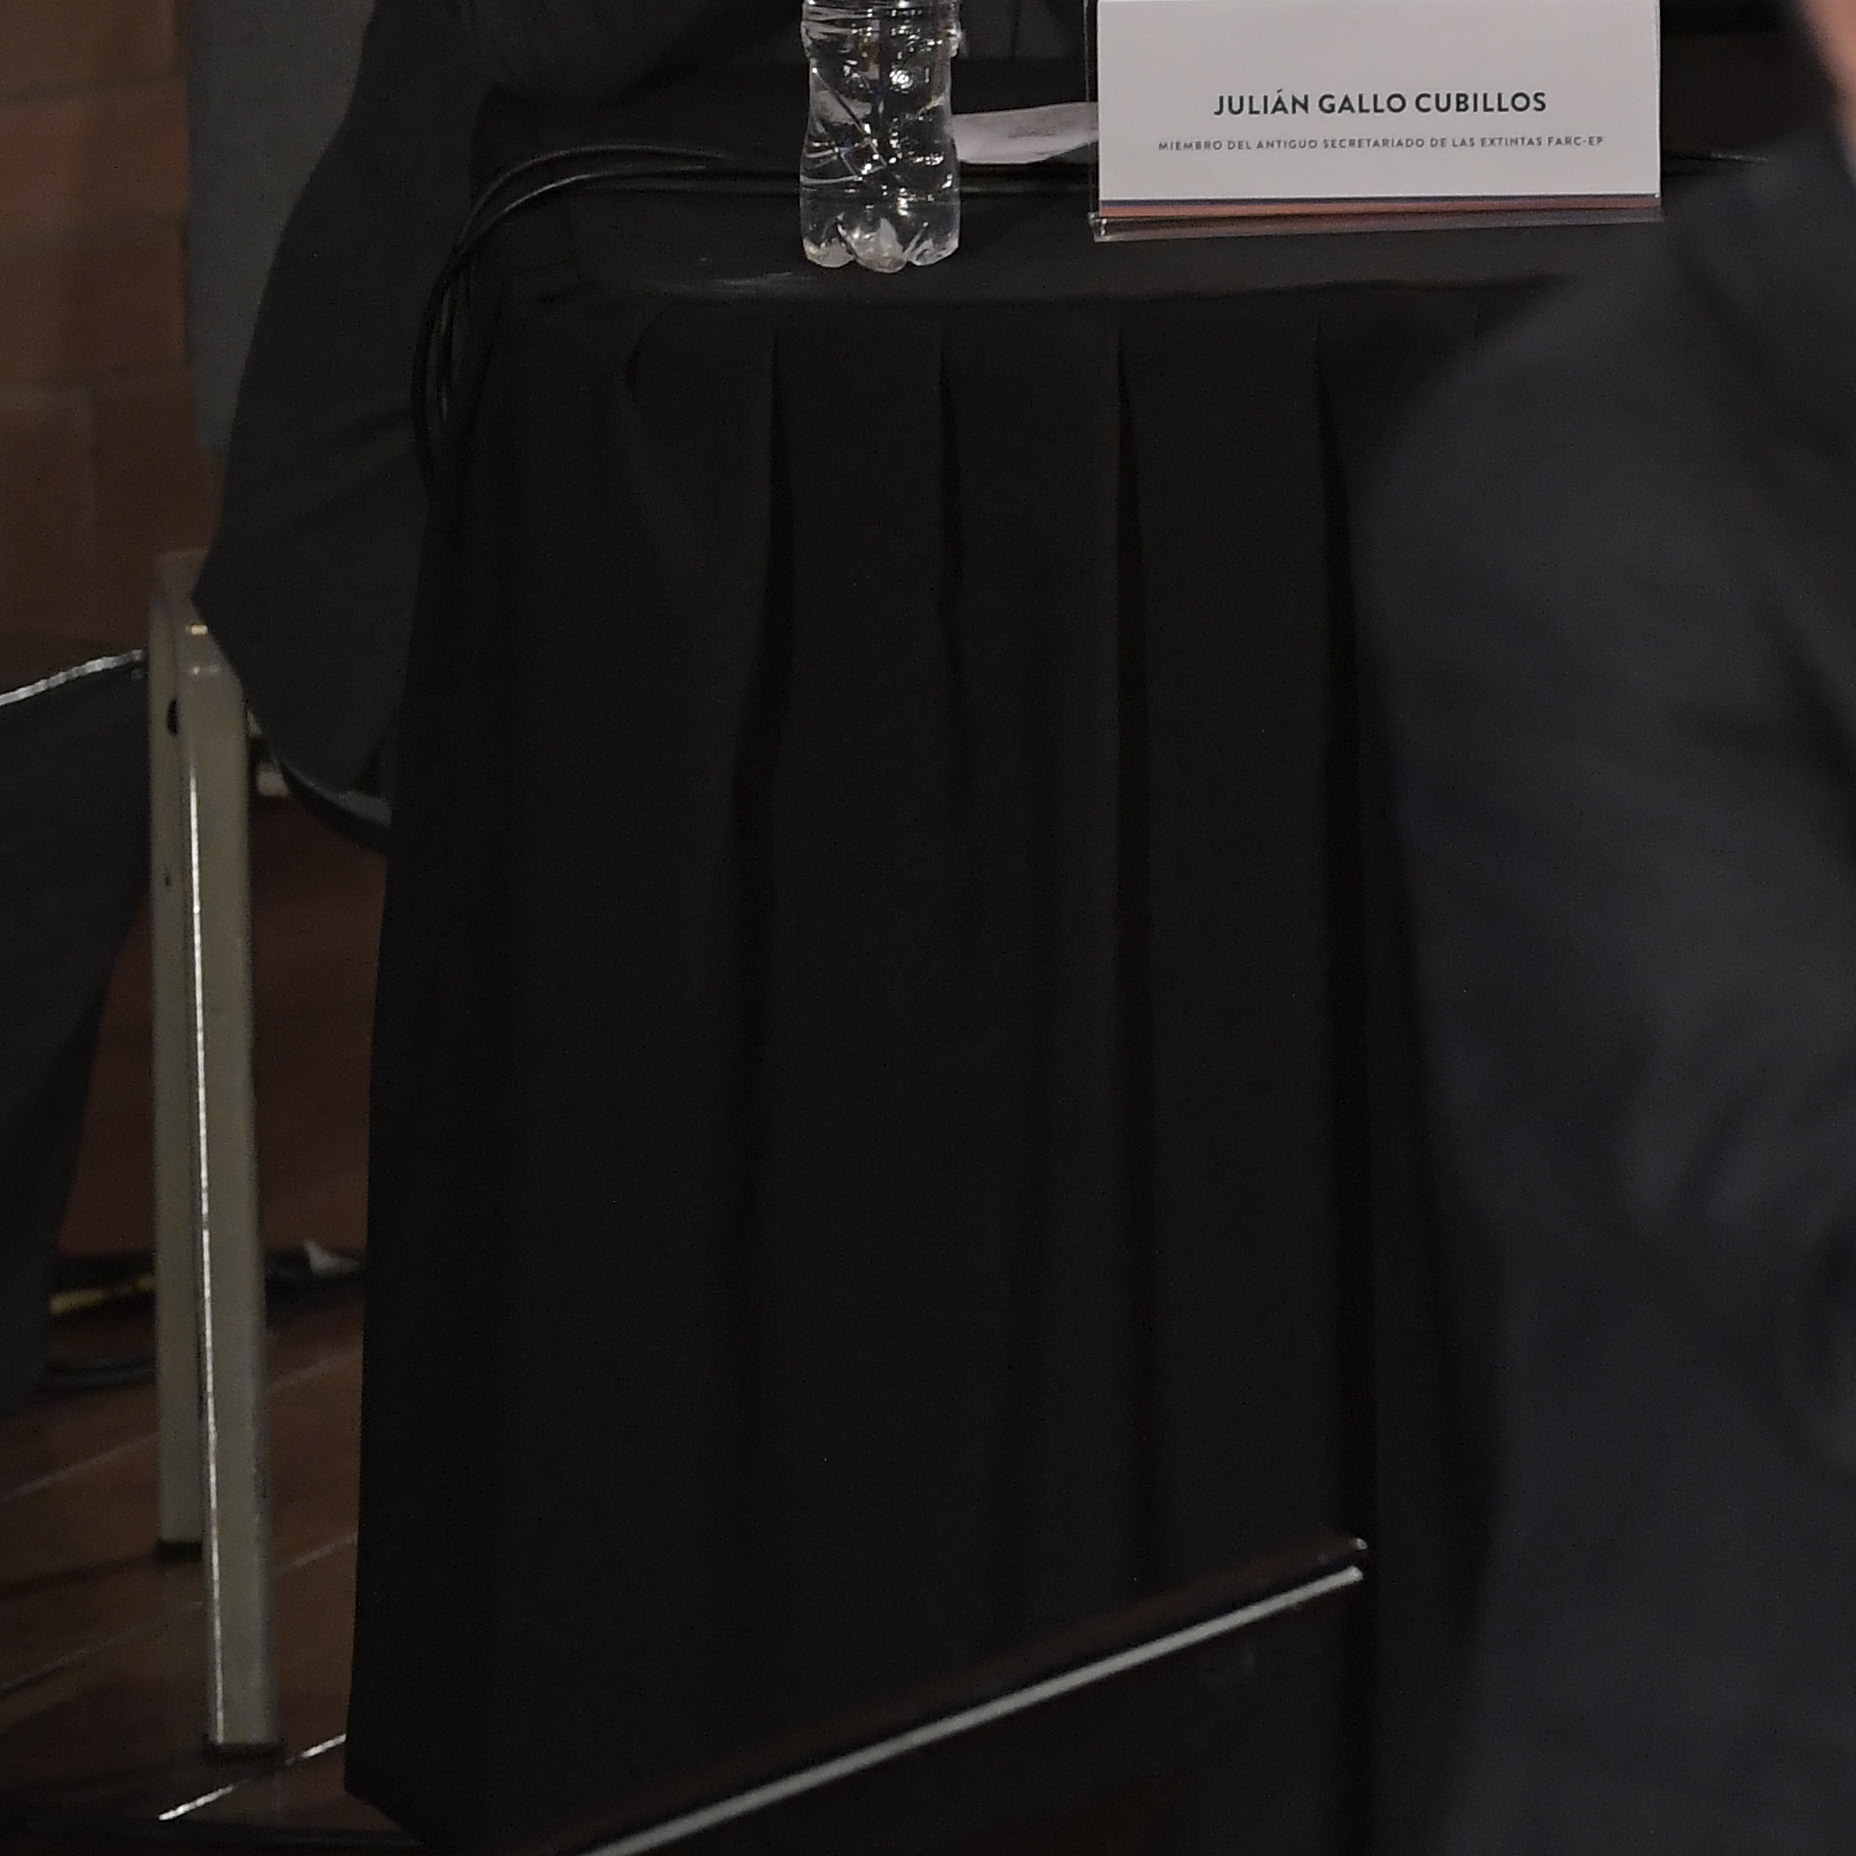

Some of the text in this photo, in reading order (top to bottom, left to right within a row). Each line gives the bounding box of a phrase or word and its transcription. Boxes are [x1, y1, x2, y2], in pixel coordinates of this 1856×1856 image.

[1213, 88, 1546, 116] JULIÁN GALLO CUBILLOS
[1157, 134, 1603, 151] MIEMBRO DEL ANTIGUO SECRETARIADO DE LAS EXTINTAS FARC-EP
